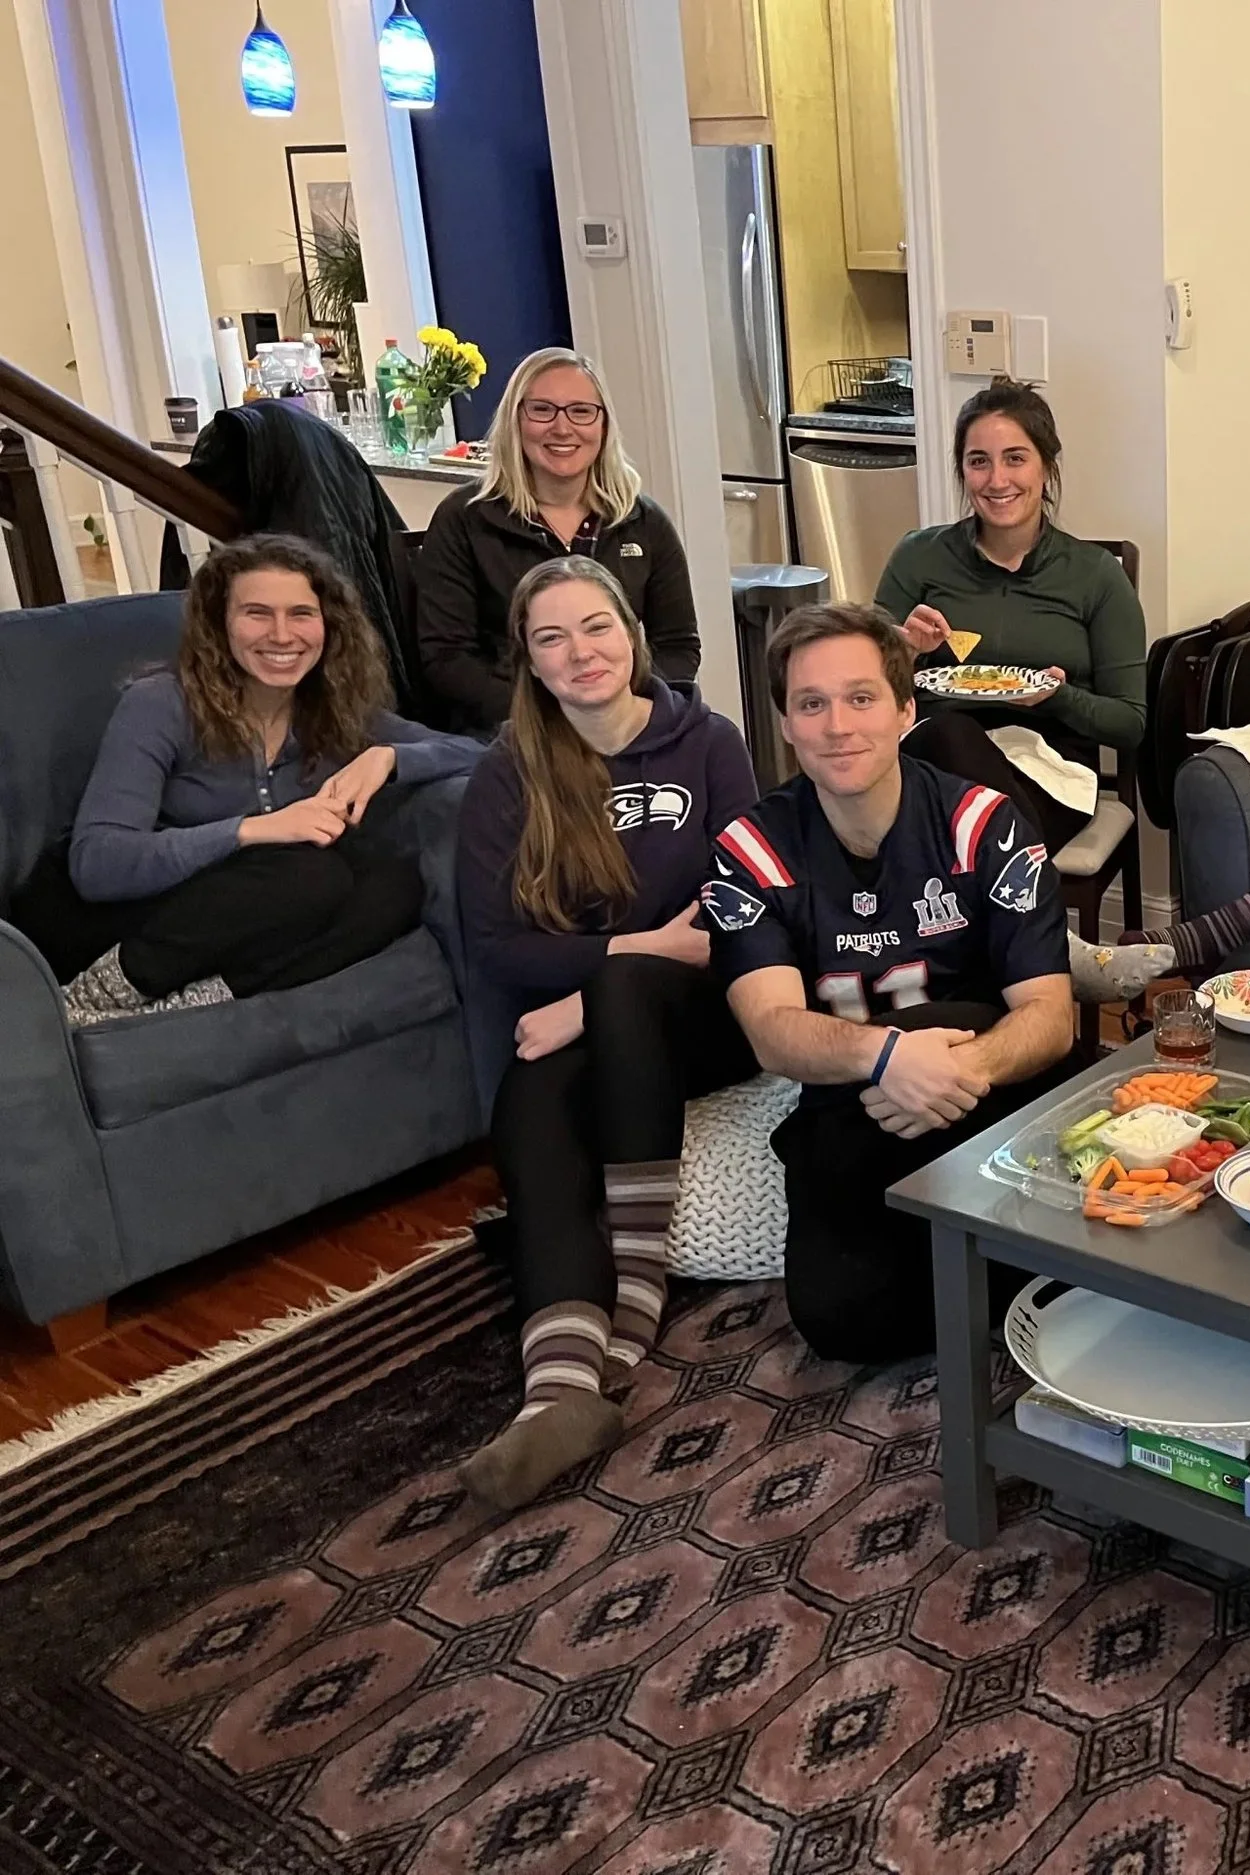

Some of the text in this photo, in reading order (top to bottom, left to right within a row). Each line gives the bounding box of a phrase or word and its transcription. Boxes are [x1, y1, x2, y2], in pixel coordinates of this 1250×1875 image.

[857, 902, 873, 912] NFL
[836, 930, 901, 952] PATRIOTS
[815, 960, 930, 1024] 11
[1160, 1443, 1211, 1468] CODENAMES
[1176, 1457, 1194, 1469] DUET
